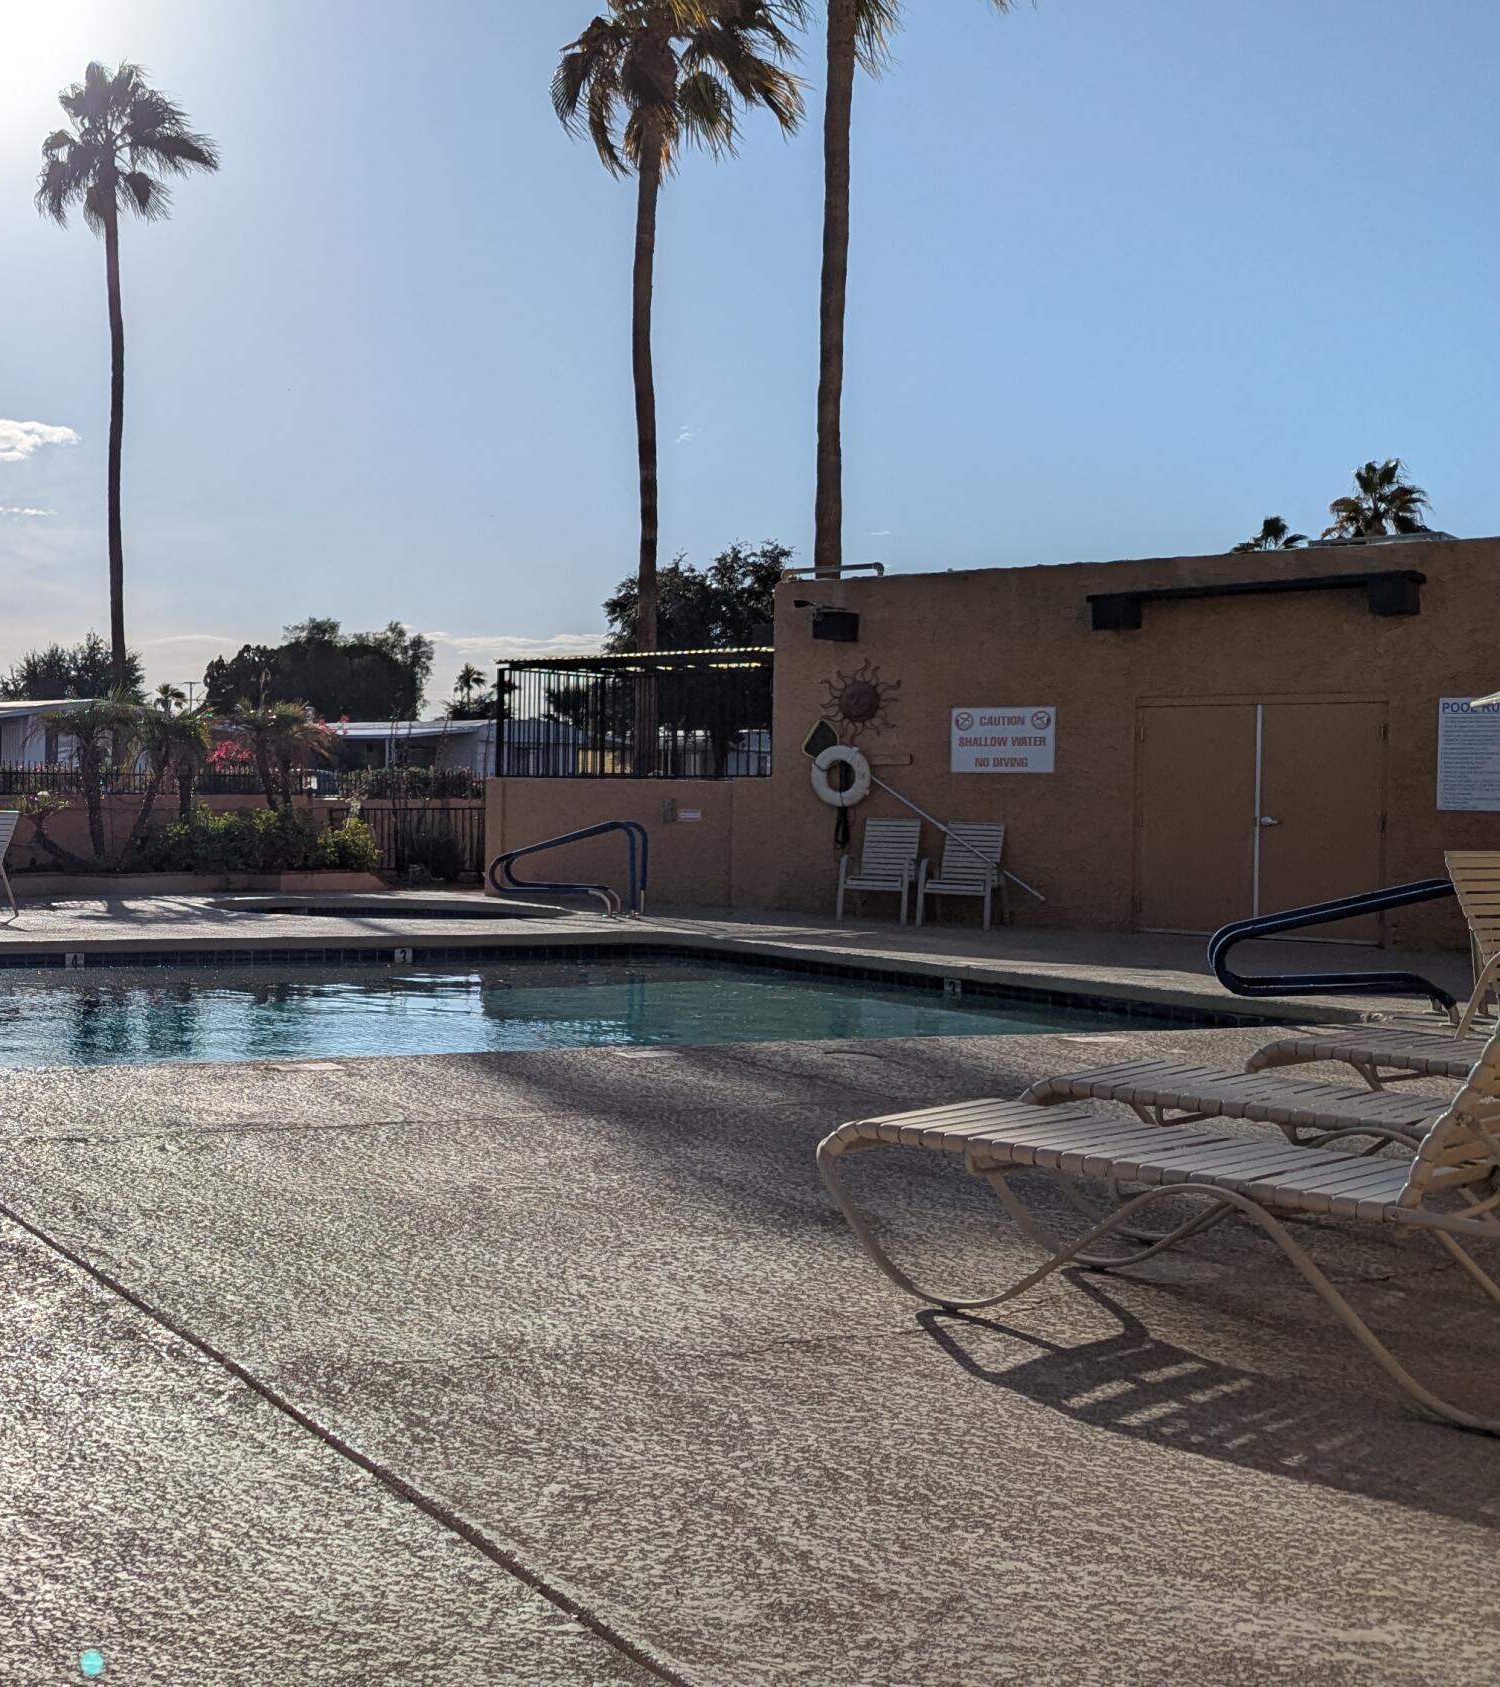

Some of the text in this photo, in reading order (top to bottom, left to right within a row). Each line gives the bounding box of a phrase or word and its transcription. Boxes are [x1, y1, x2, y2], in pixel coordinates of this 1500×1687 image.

[980, 715, 1026, 727] CAUTION
[958, 736, 1046, 747] SHALLOW WATER
[974, 757, 1028, 767] NO DIVING
